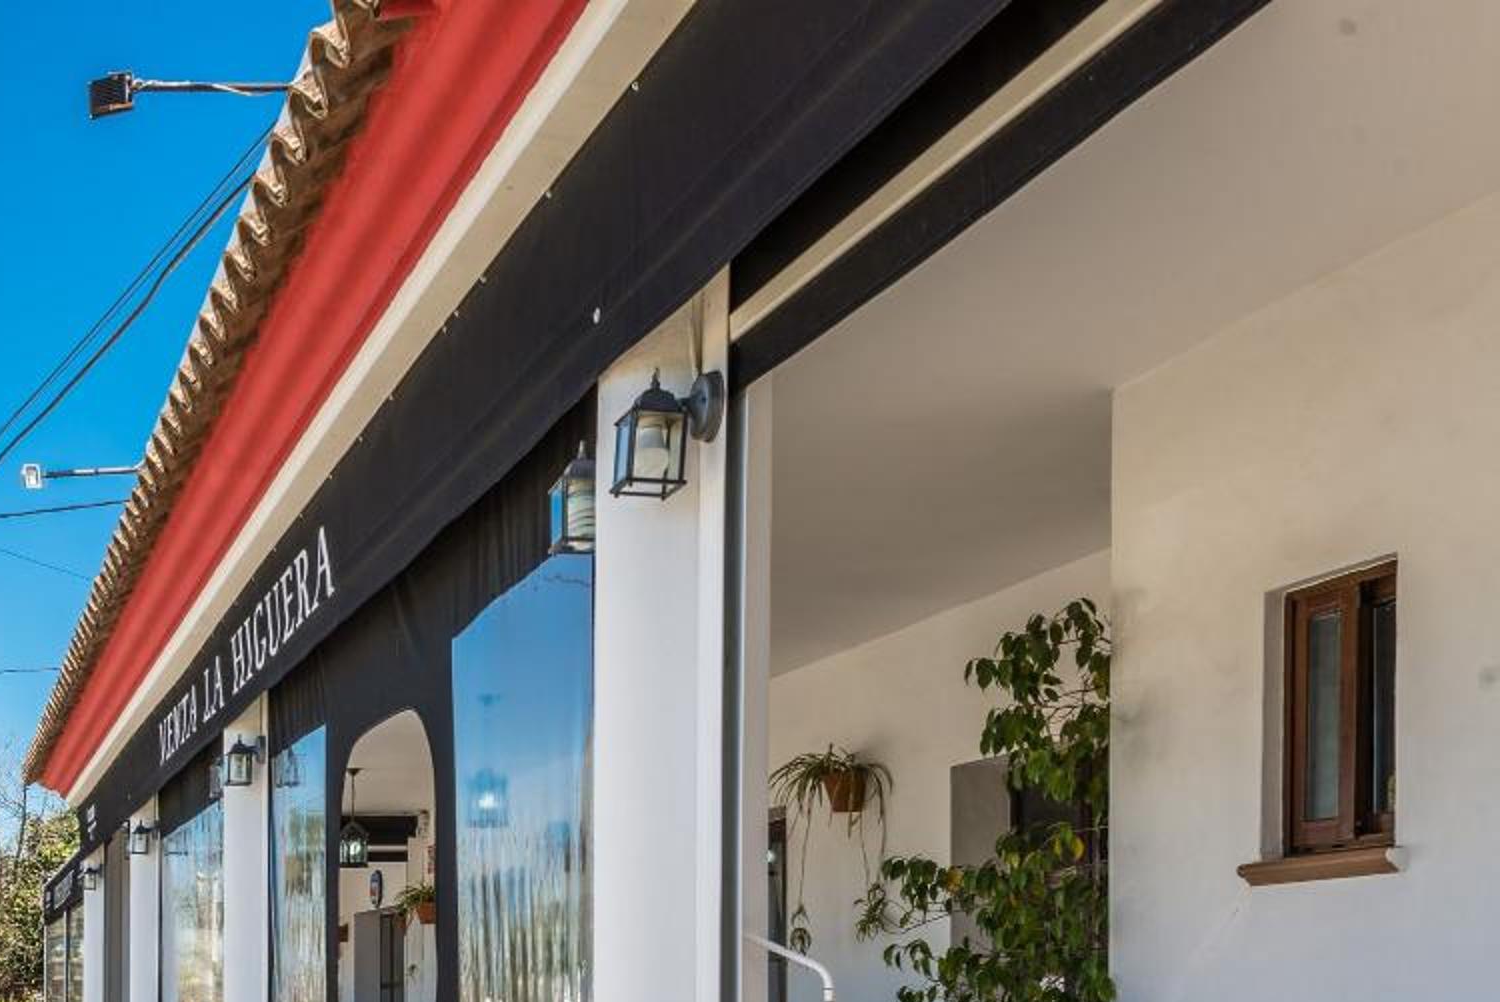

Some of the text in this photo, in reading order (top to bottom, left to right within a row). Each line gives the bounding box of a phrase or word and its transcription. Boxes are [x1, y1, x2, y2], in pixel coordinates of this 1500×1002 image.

[158, 526, 335, 767] VENTA LA HIGUERA
